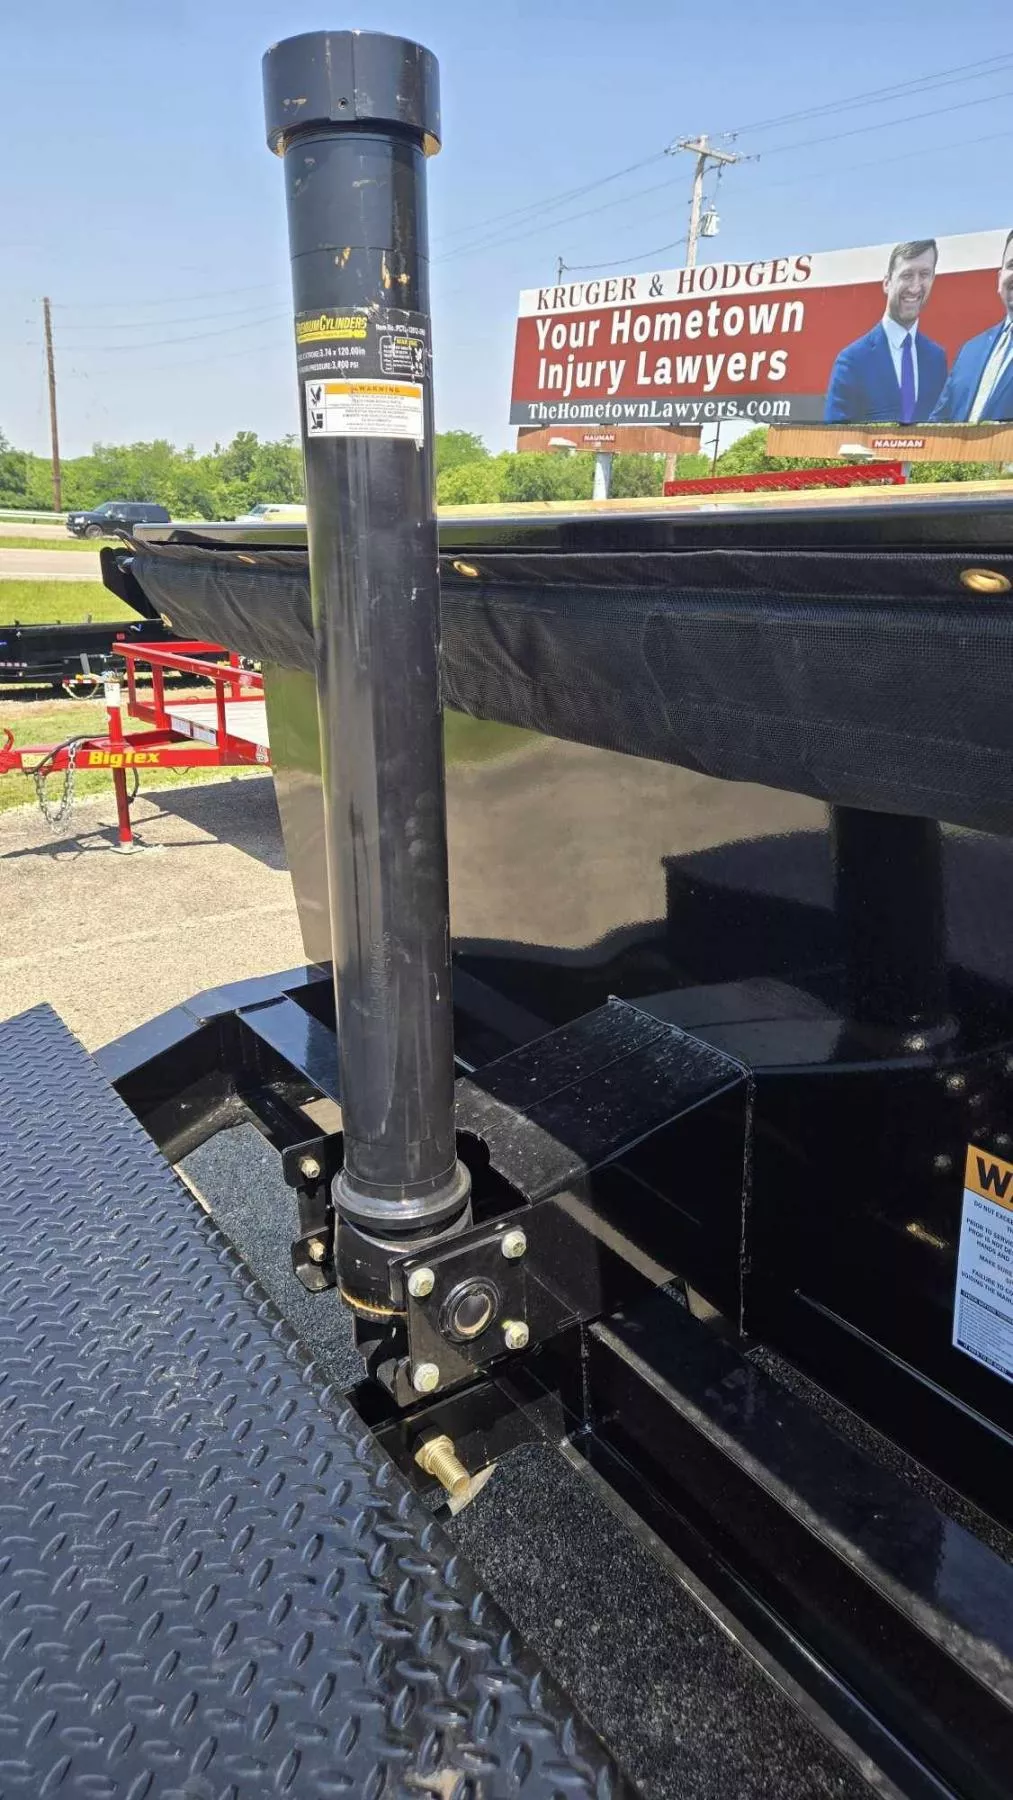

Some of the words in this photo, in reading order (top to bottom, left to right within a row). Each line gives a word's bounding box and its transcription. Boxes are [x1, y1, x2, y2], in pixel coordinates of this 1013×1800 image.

[537, 276, 638, 310] KRUGER
[648, 274, 664, 297] &
[677, 255, 812, 294] HODGES
[536, 317, 600, 351] Your
[610, 300, 805, 344] Hometown
[537, 352, 626, 397] Injury
[637, 349, 788, 391] Lawyers
[528, 398, 791, 422] TheHometownLawyers.com
[88, 751, 160, 768] BigTex
